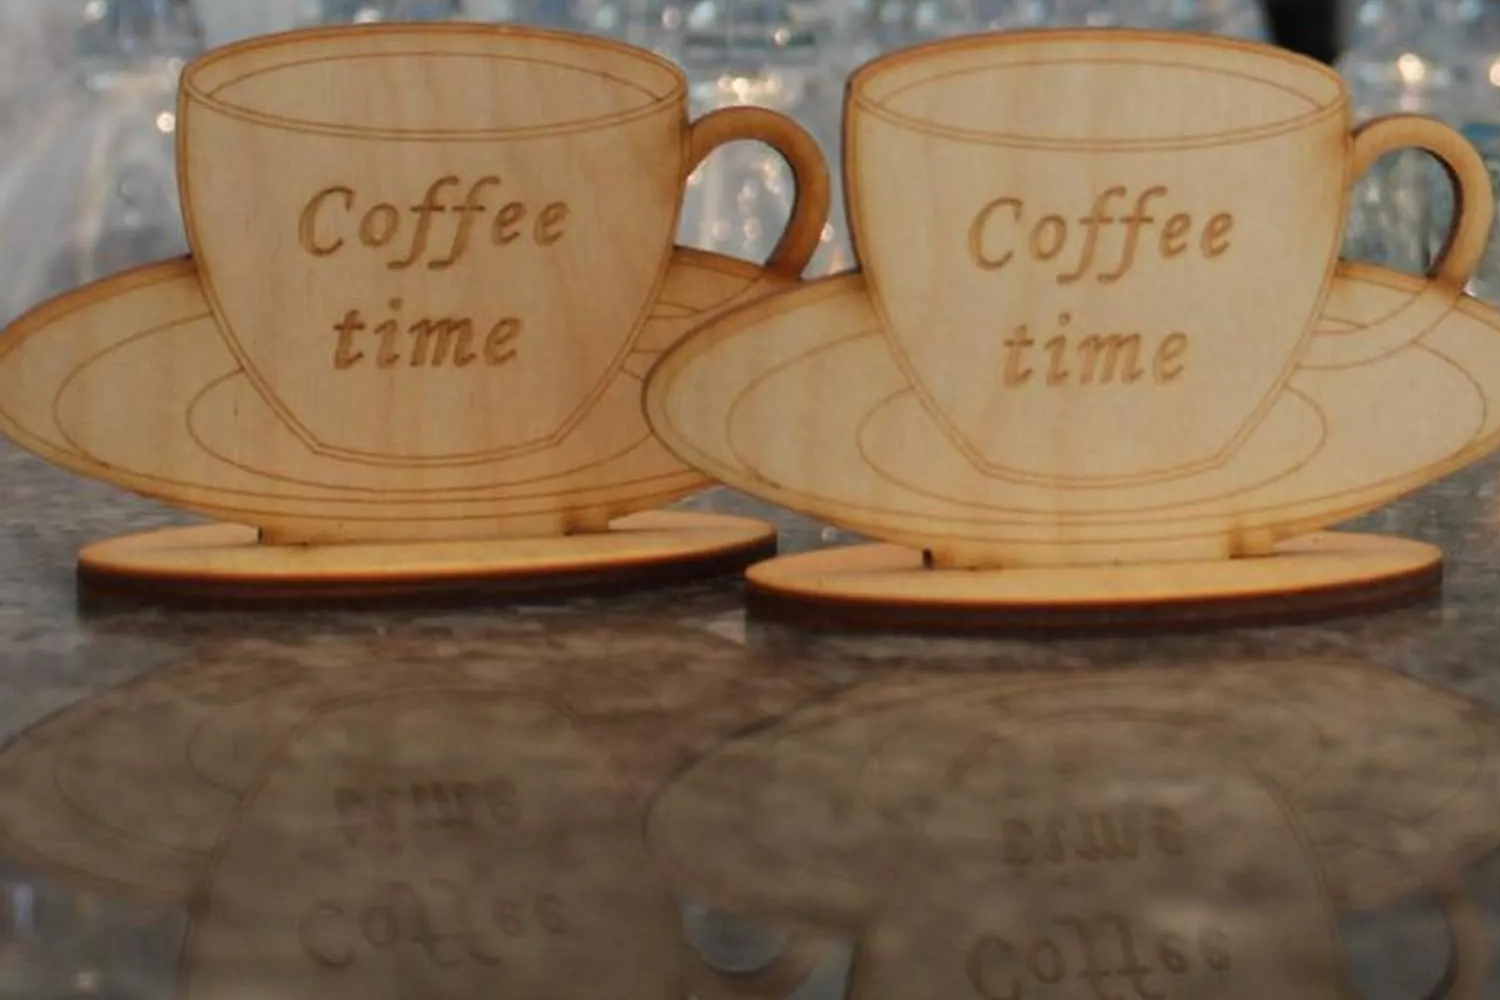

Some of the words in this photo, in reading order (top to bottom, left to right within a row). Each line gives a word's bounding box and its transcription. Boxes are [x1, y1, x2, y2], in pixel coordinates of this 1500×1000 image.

[298, 175, 569, 270] Coffee
[967, 185, 1234, 285] Coffee
[332, 298, 521, 371] time
[1002, 313, 1188, 388] time
